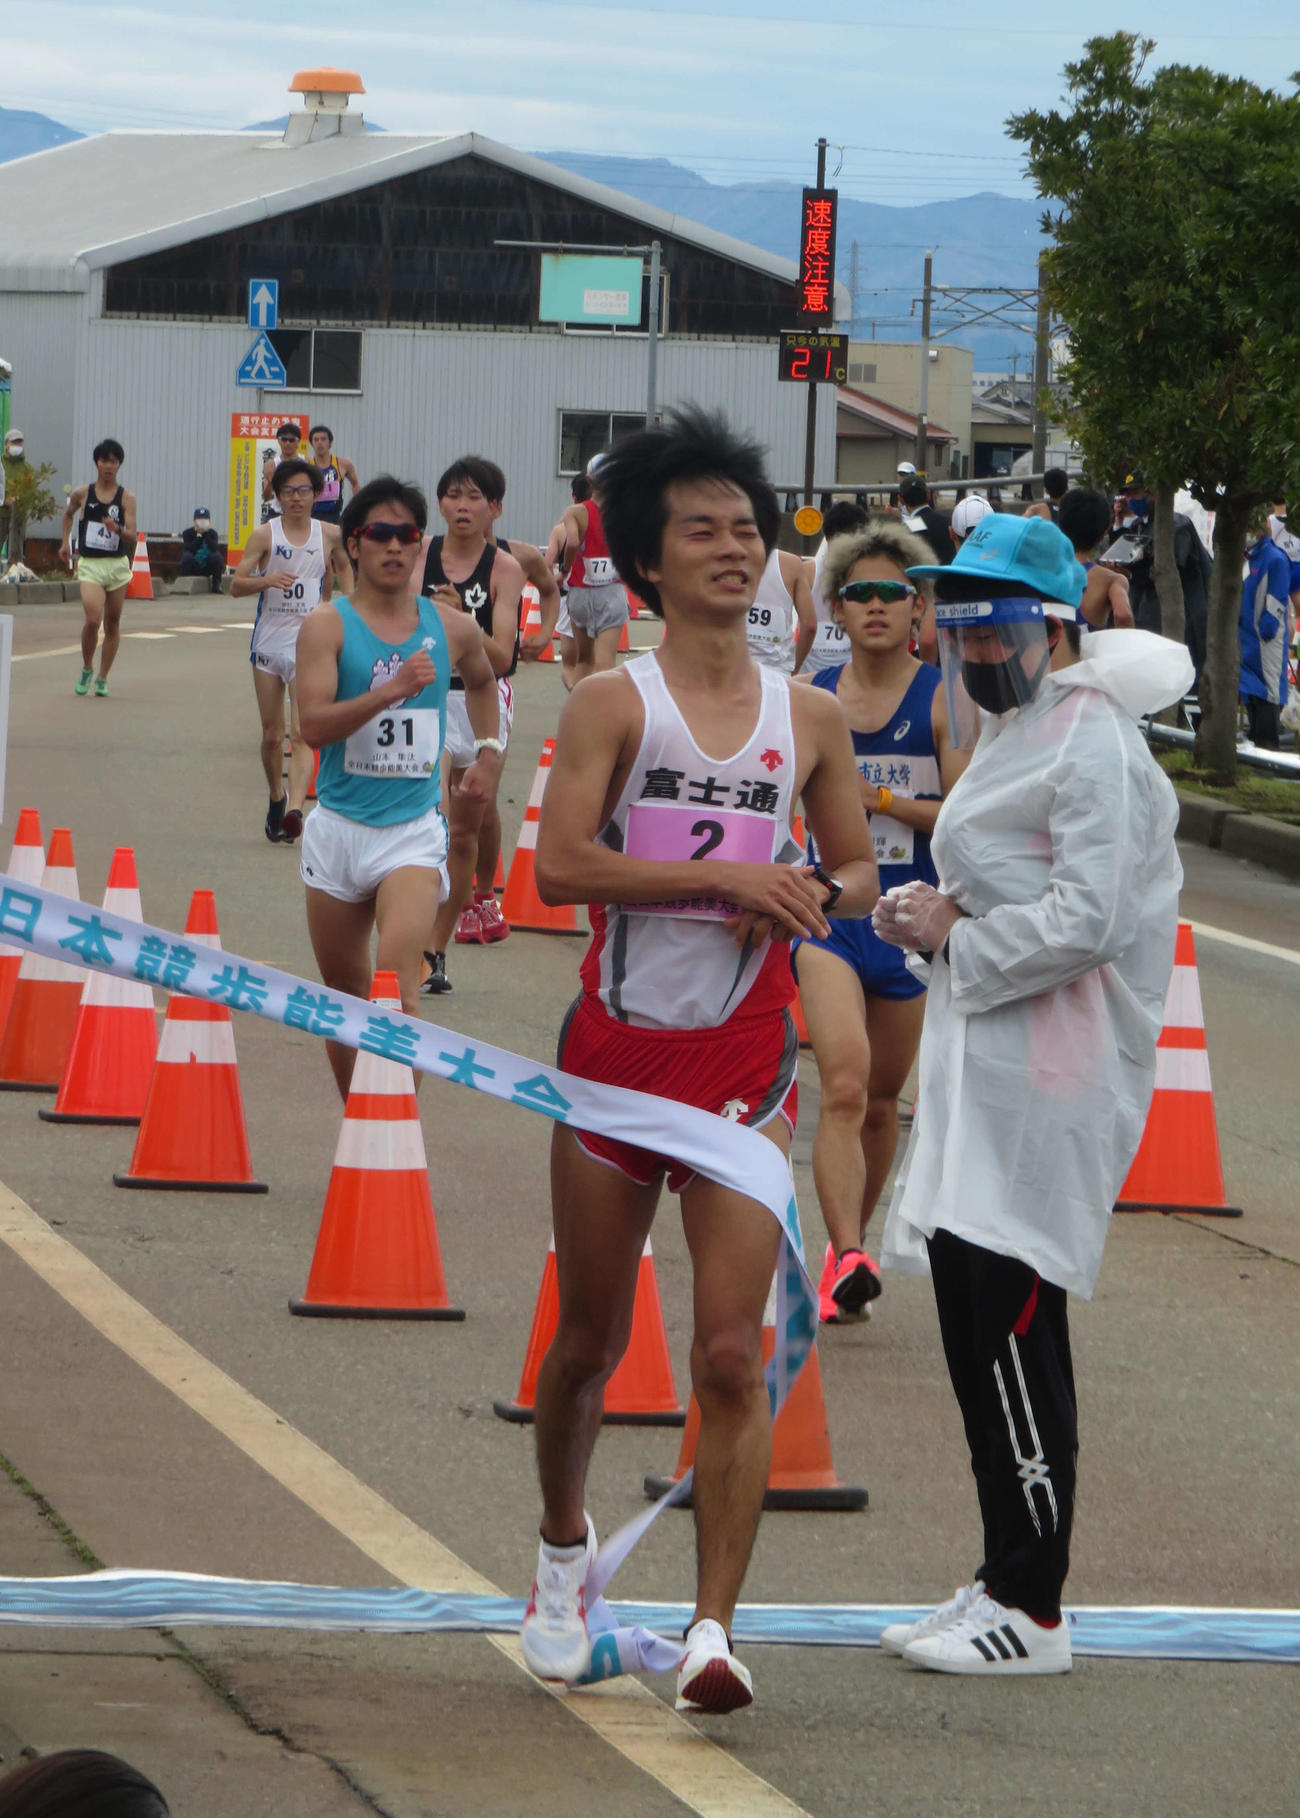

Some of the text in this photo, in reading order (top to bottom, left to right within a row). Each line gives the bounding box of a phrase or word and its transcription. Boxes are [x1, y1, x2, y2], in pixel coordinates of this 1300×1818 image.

[803, 199, 832, 312] 速度注意
[786, 335, 841, 348] 只今の気温
[791, 348, 832, 379] 21
[276, 544, 292, 560] KU
[592, 561, 608, 573] 77
[748, 607, 772, 626] 59
[949, 604, 978, 616] shield
[377, 718, 414, 747] 31
[639, 767, 780, 815] 富士通
[690, 819, 725, 861] 2
